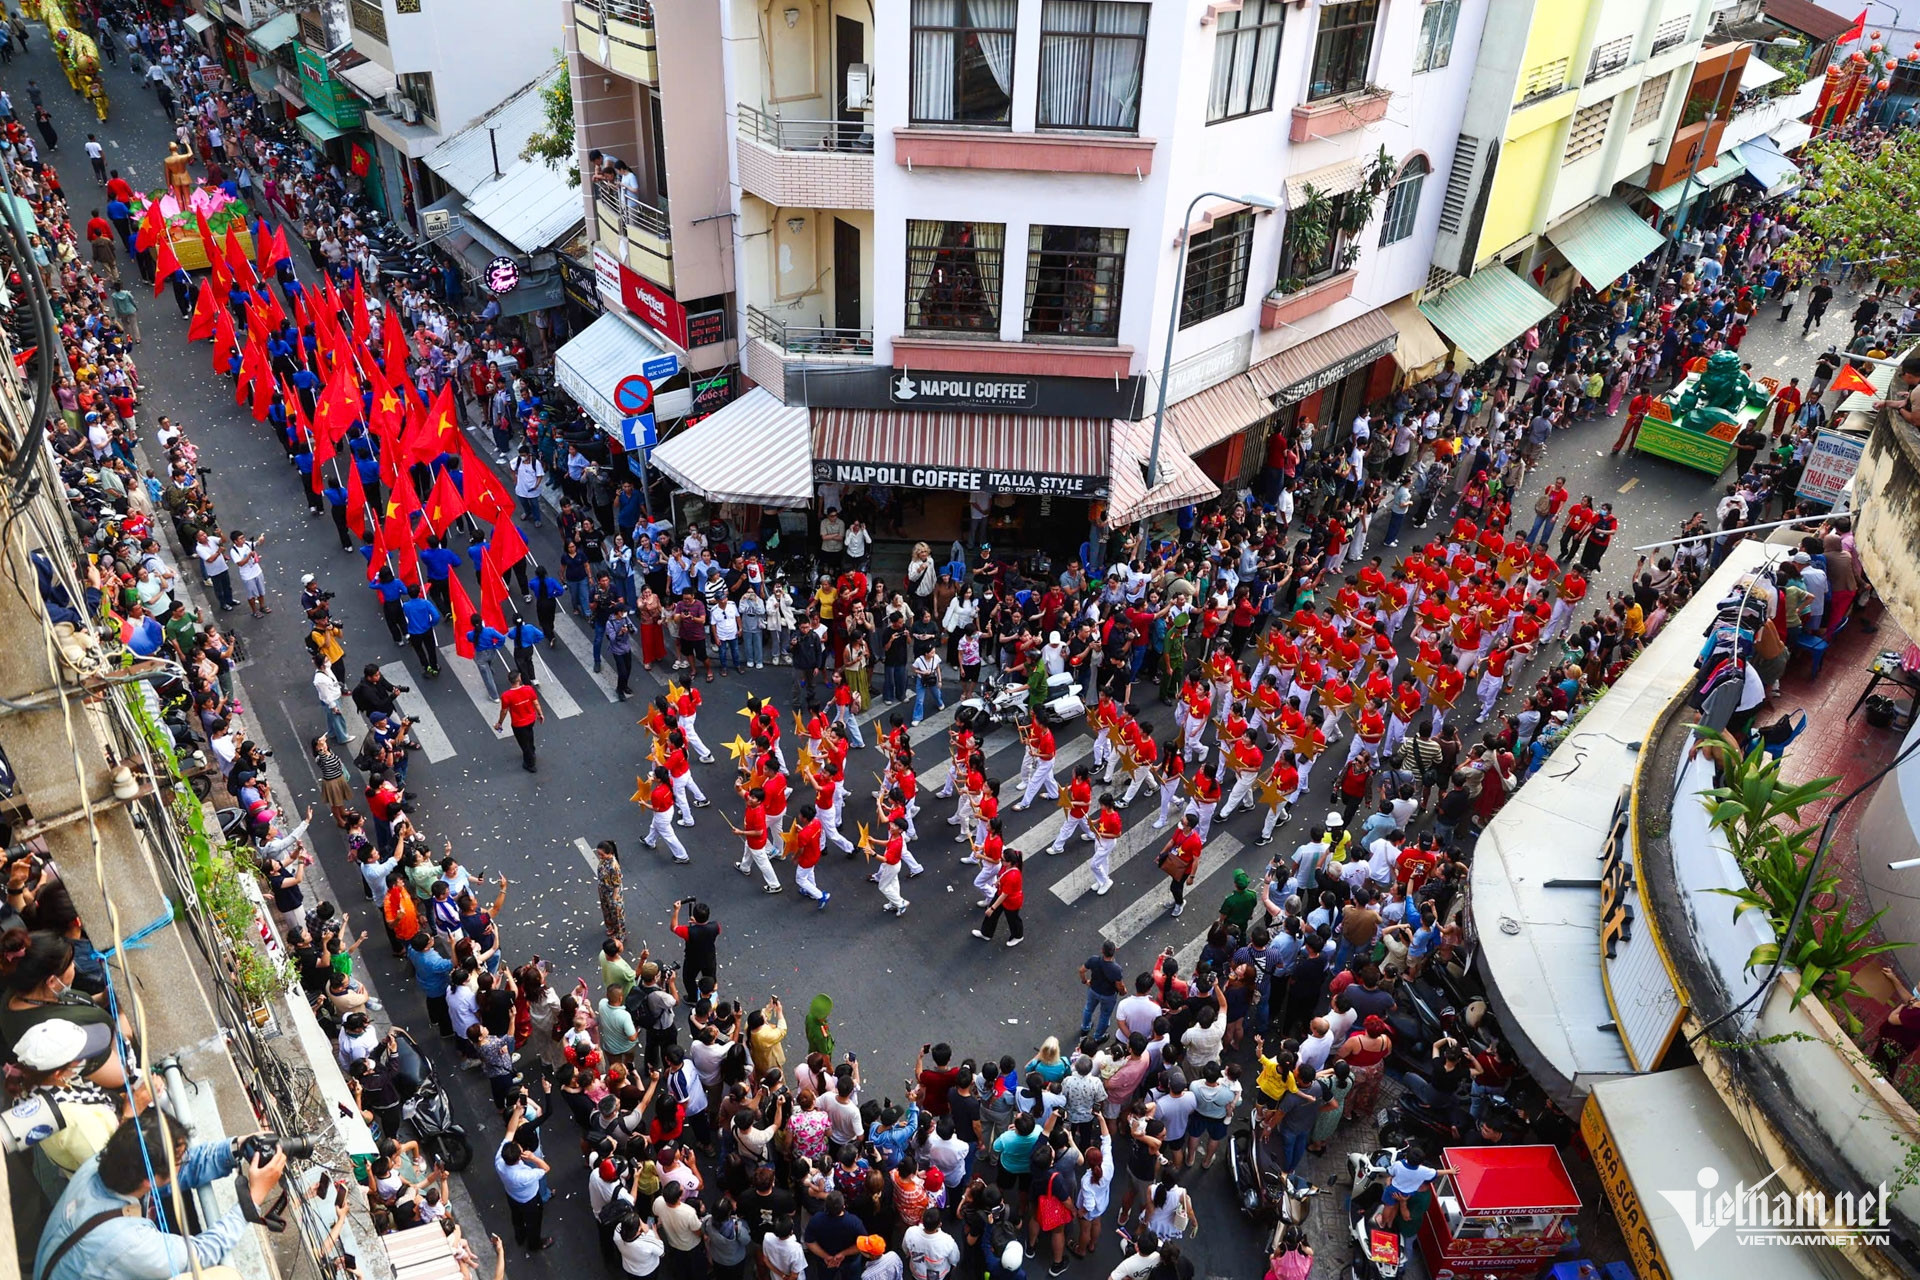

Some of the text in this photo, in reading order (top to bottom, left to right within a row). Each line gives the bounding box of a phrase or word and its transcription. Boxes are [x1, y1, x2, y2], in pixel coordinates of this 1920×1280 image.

[1318, 362, 1346, 388] COFFEE
[920, 380, 1027, 399] NAPOLI COFFEE
[836, 465, 1084, 491] NAPOLI COFFEE ITALIA STYLE
